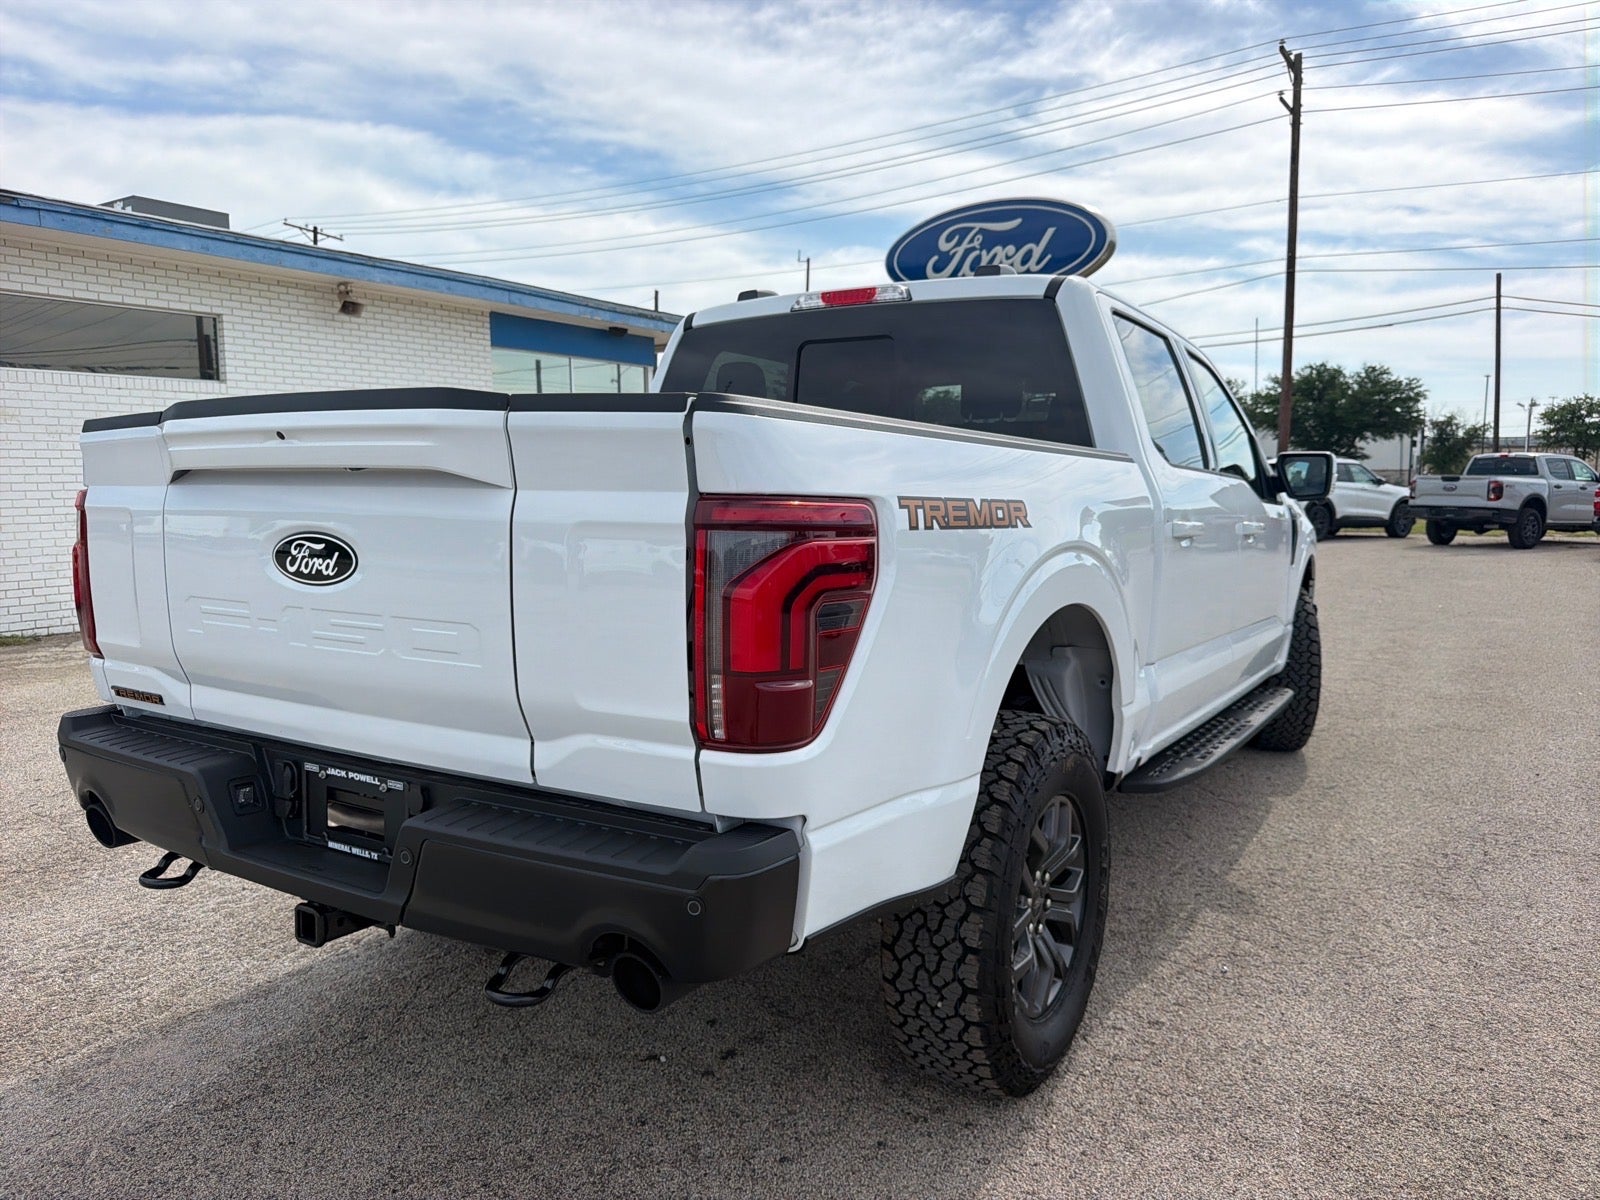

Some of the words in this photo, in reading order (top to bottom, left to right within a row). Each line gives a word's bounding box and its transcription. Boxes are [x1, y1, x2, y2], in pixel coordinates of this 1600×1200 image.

[925, 218, 1057, 279] Ford
[897, 495, 1033, 530] TREMOR
[285, 540, 339, 576] Ford
[184, 595, 482, 668] F-150
[326, 768, 347, 778] JACK
[348, 771, 381, 785] POWELL
[328, 841, 351, 853] MINERAL
[371, 852, 379, 860] TX
